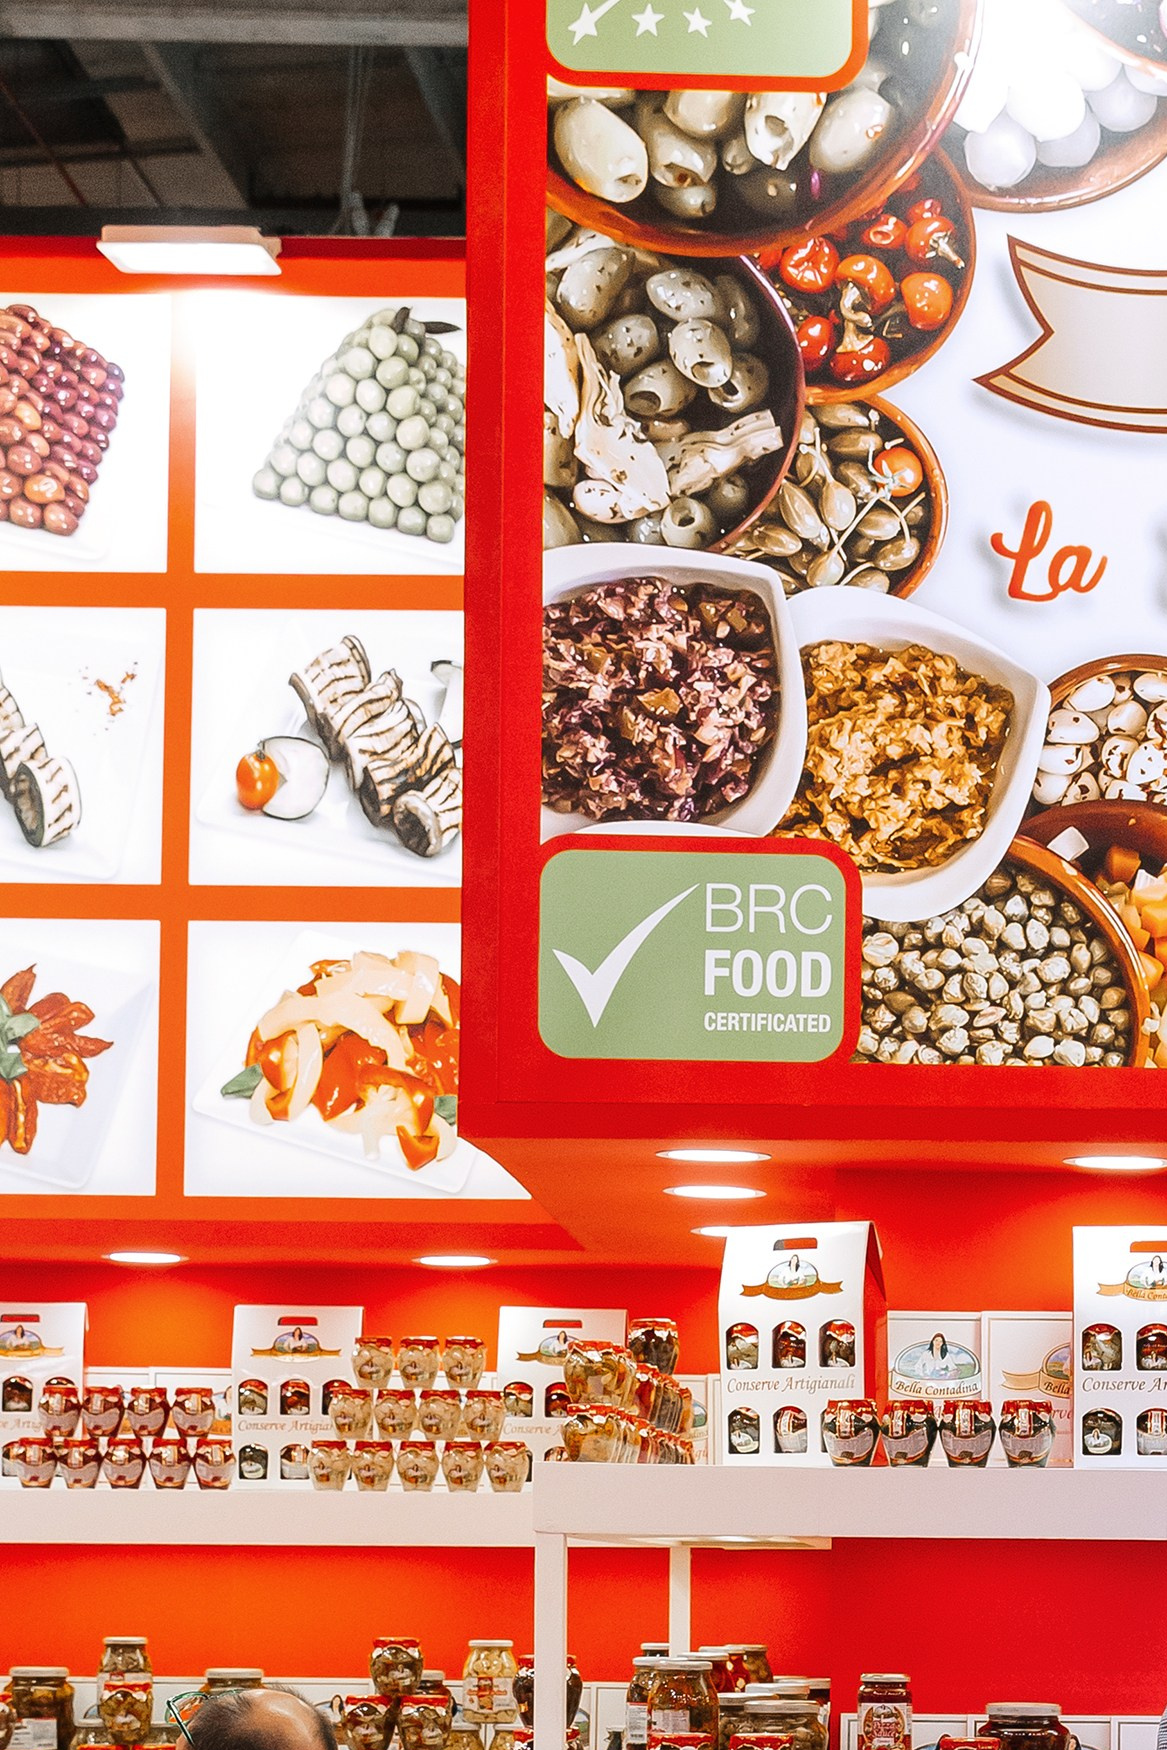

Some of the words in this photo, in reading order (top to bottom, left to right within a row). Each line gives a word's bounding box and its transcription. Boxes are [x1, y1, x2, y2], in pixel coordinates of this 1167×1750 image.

[991, 500, 1107, 603] La
[705, 882, 834, 935] BRC
[704, 949, 832, 998] FOOD
[703, 1011, 832, 1034] CERTIFICATED
[727, 1377, 781, 1393] Conserve
[782, 1373, 855, 1395] Artigianali
[895, 1379, 923, 1395] Bella
[924, 1379, 979, 1396] Contadina
[1082, 1376, 1146, 1392] Conserve
